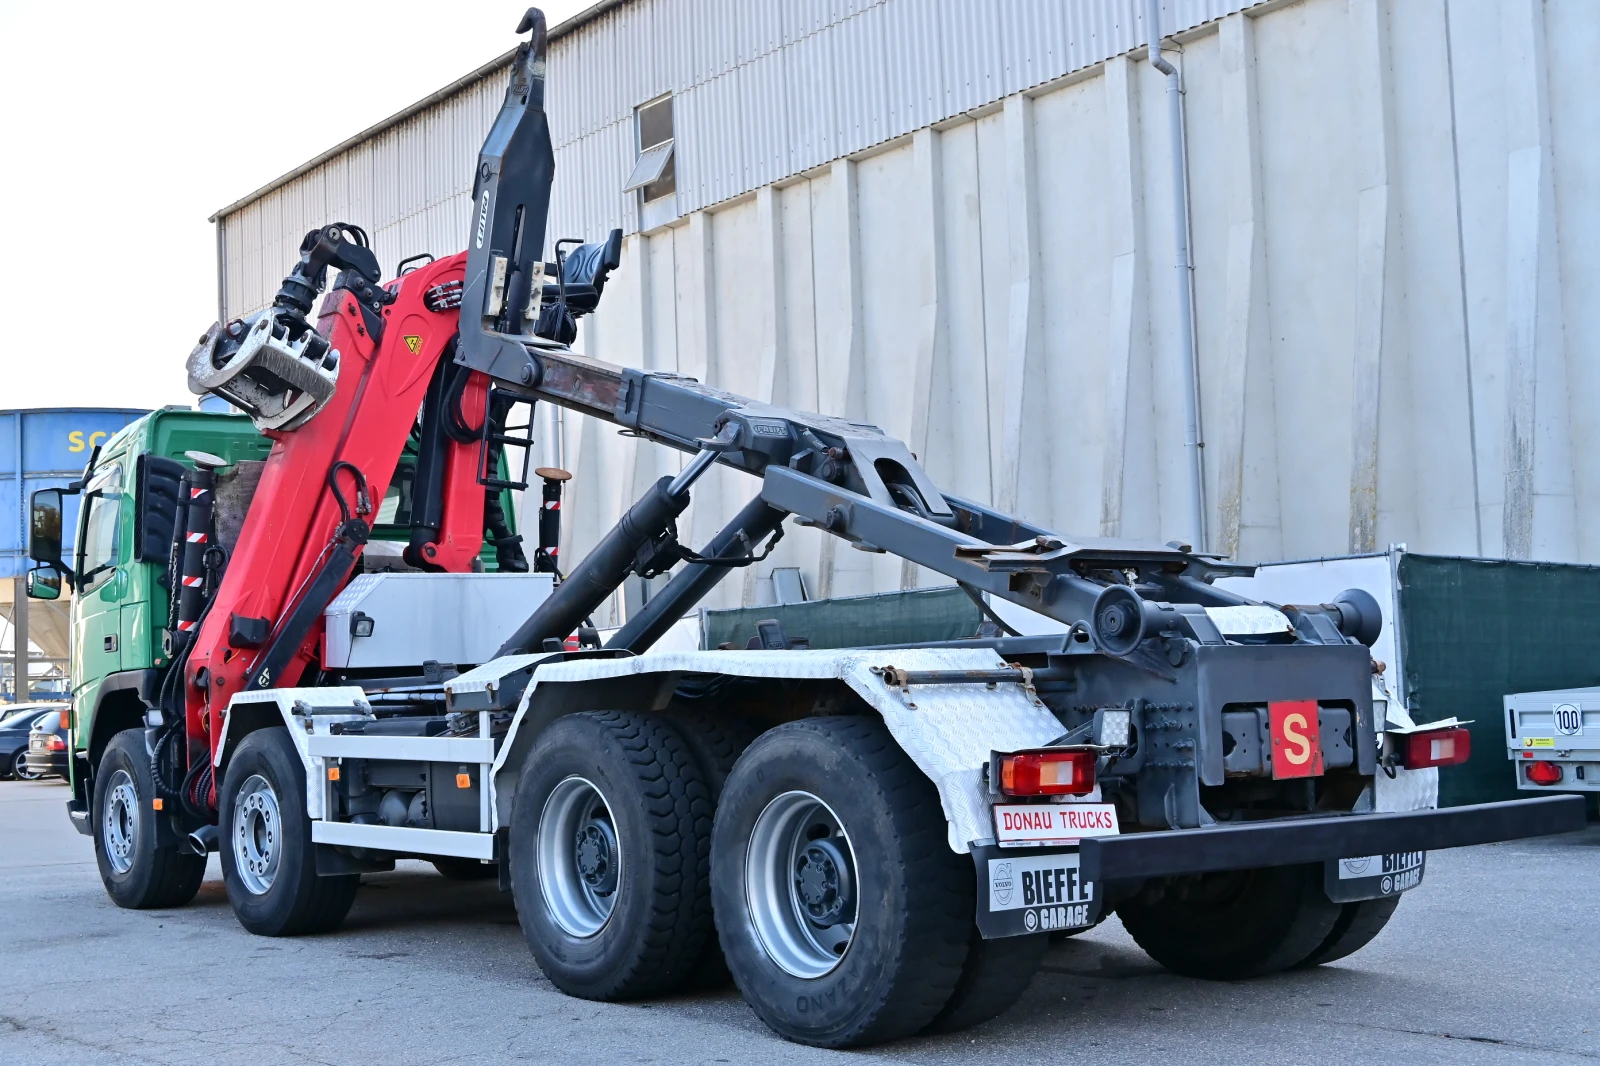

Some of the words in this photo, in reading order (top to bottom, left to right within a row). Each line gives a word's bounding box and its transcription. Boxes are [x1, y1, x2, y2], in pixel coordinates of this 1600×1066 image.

[478, 195, 488, 245] PALIFT
[69, 430, 112, 452] SC
[1557, 711, 1578, 730] 100
[1284, 713, 1310, 764] S
[1003, 811, 1053, 831] DONAU
[1059, 811, 1113, 829] TRUCKS
[1394, 867, 1420, 891] GARAGE
[1040, 904, 1088, 930] GARAGE
